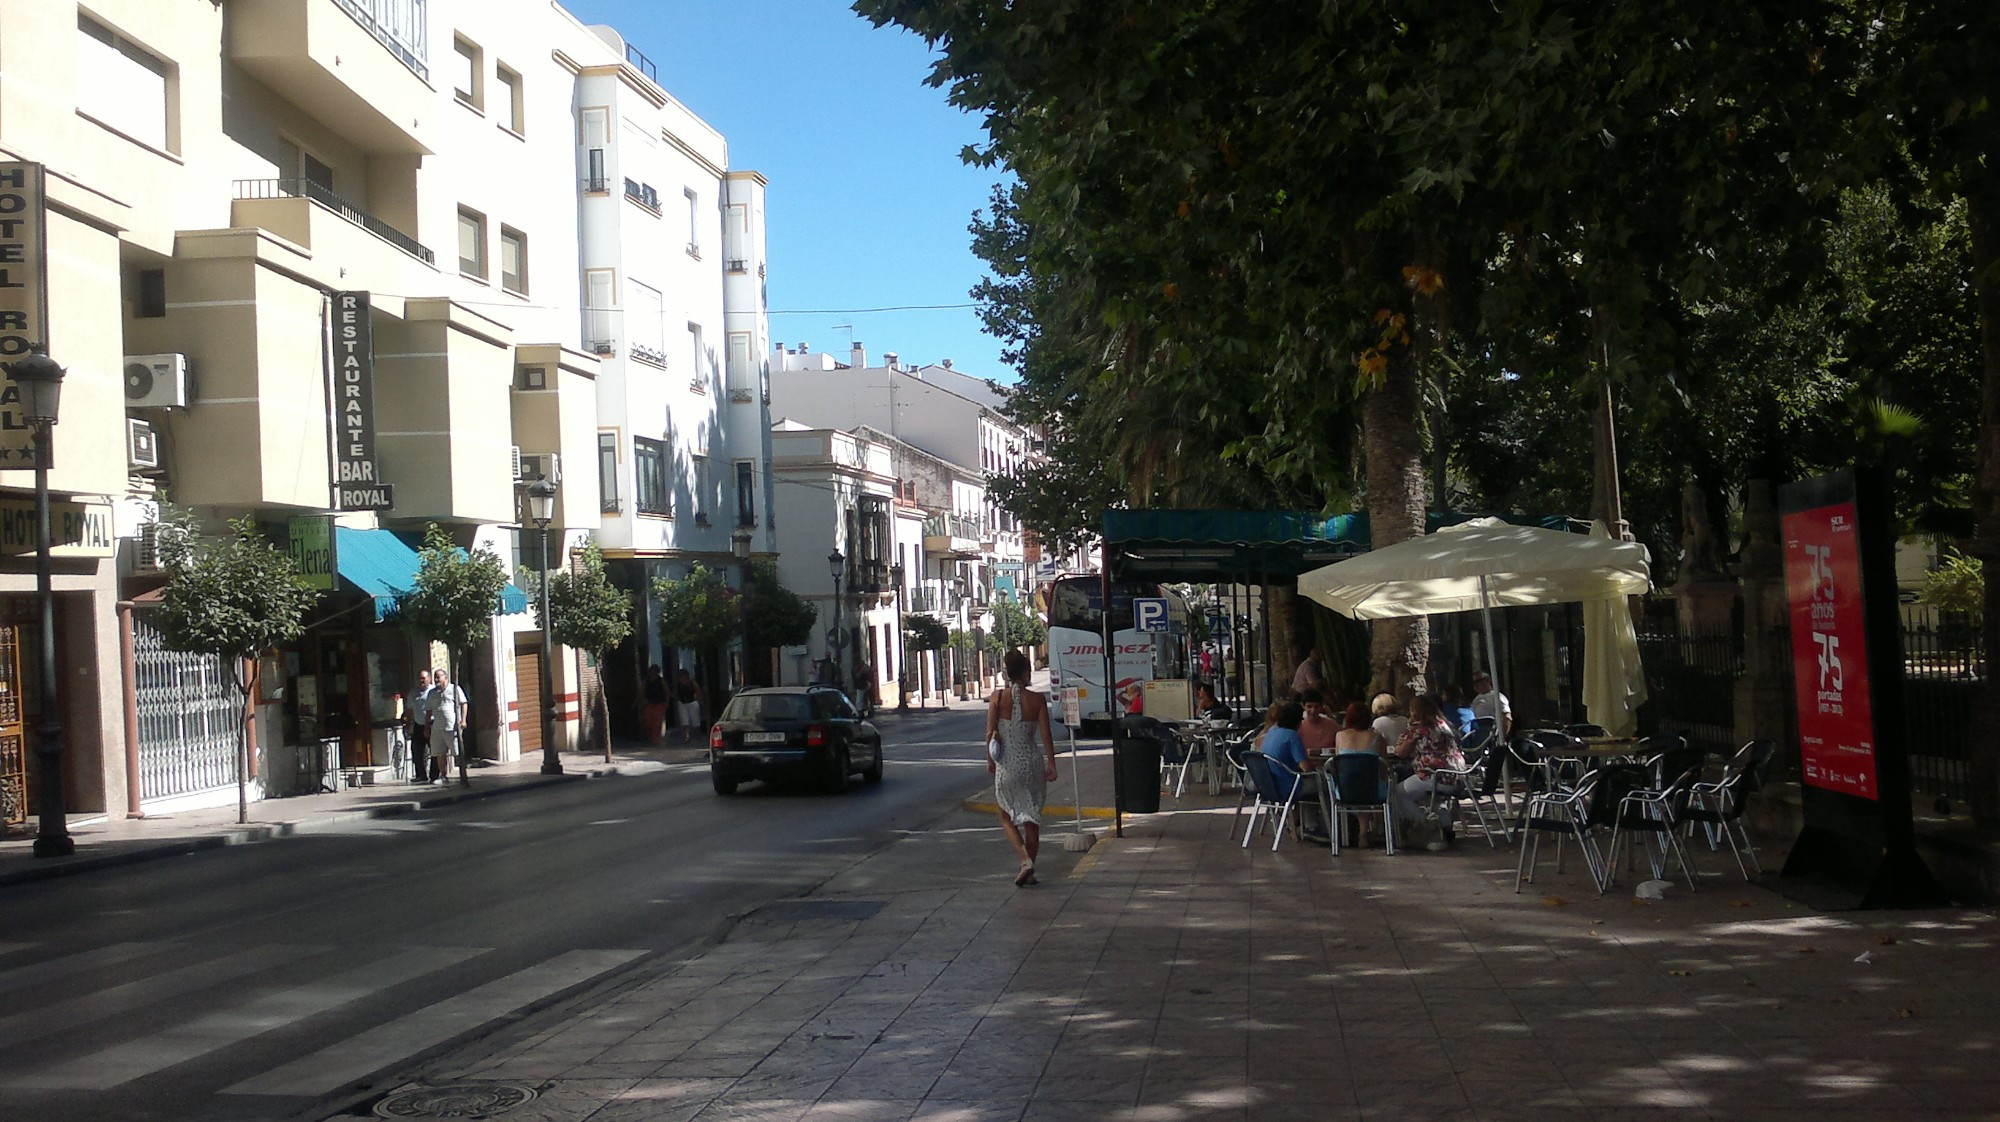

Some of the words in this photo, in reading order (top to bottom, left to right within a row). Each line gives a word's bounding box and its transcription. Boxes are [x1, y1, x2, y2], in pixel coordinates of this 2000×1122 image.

[0, 168, 27, 287] HOTEL
[342, 296, 364, 457] RESTAURANTE
[340, 460, 373, 482] BAR
[343, 489, 390, 507] ROYAL
[3, 508, 55, 545] HOTL
[63, 511, 110, 547] ROYAL
[290, 536, 332, 575] Elena
[1805, 544, 1834, 601] 75
[1139, 601, 1163, 631] P
[1811, 602, 1835, 619] años
[1812, 631, 1843, 690] 75
